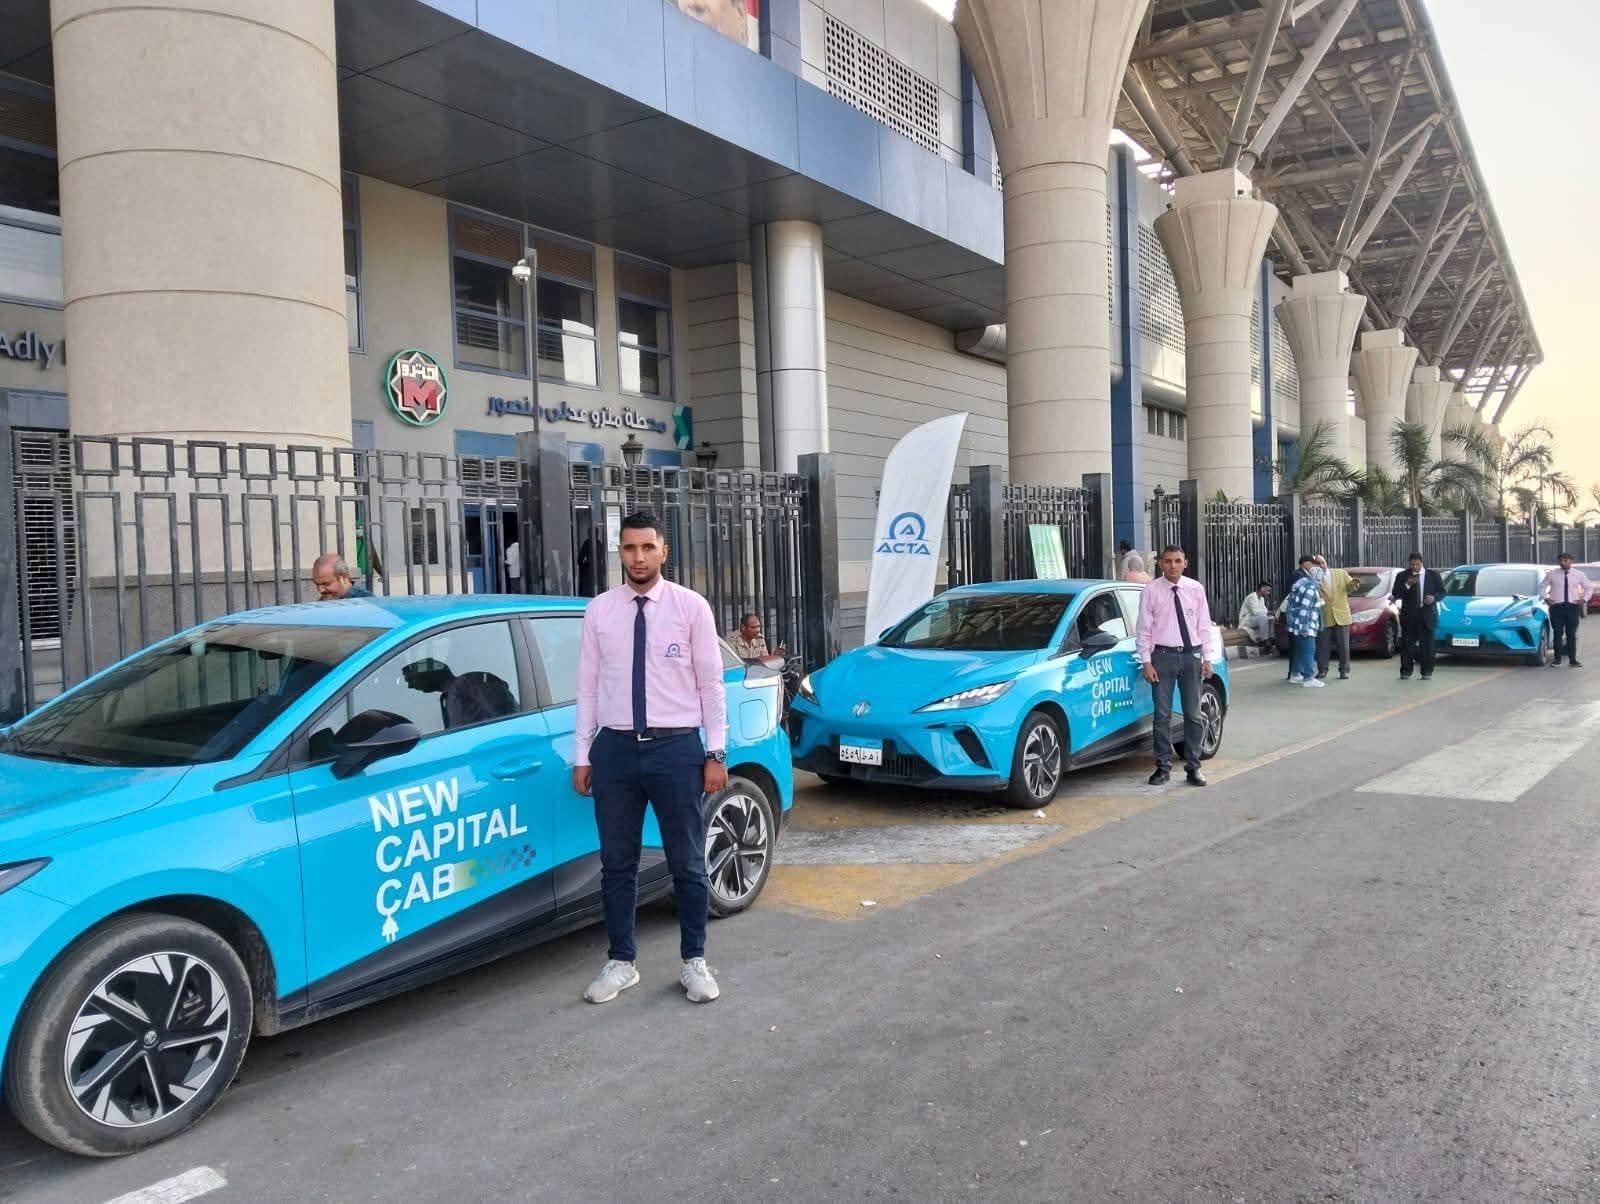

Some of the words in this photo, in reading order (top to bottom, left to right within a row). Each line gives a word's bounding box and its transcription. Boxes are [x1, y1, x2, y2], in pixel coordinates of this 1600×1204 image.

[0, 330, 57, 369] Adly
[401, 377, 437, 411] M
[591, 406, 623, 429] مترو
[624, 406, 667, 433] محطة
[876, 542, 930, 555] ACTA
[1087, 657, 1113, 677] NEW
[1092, 676, 1130, 699] CAPITAL
[1091, 700, 1111, 718] CAB
[368, 777, 459, 832] NEW
[375, 804, 528, 873] CAPITAL
[376, 863, 455, 917] CAB
